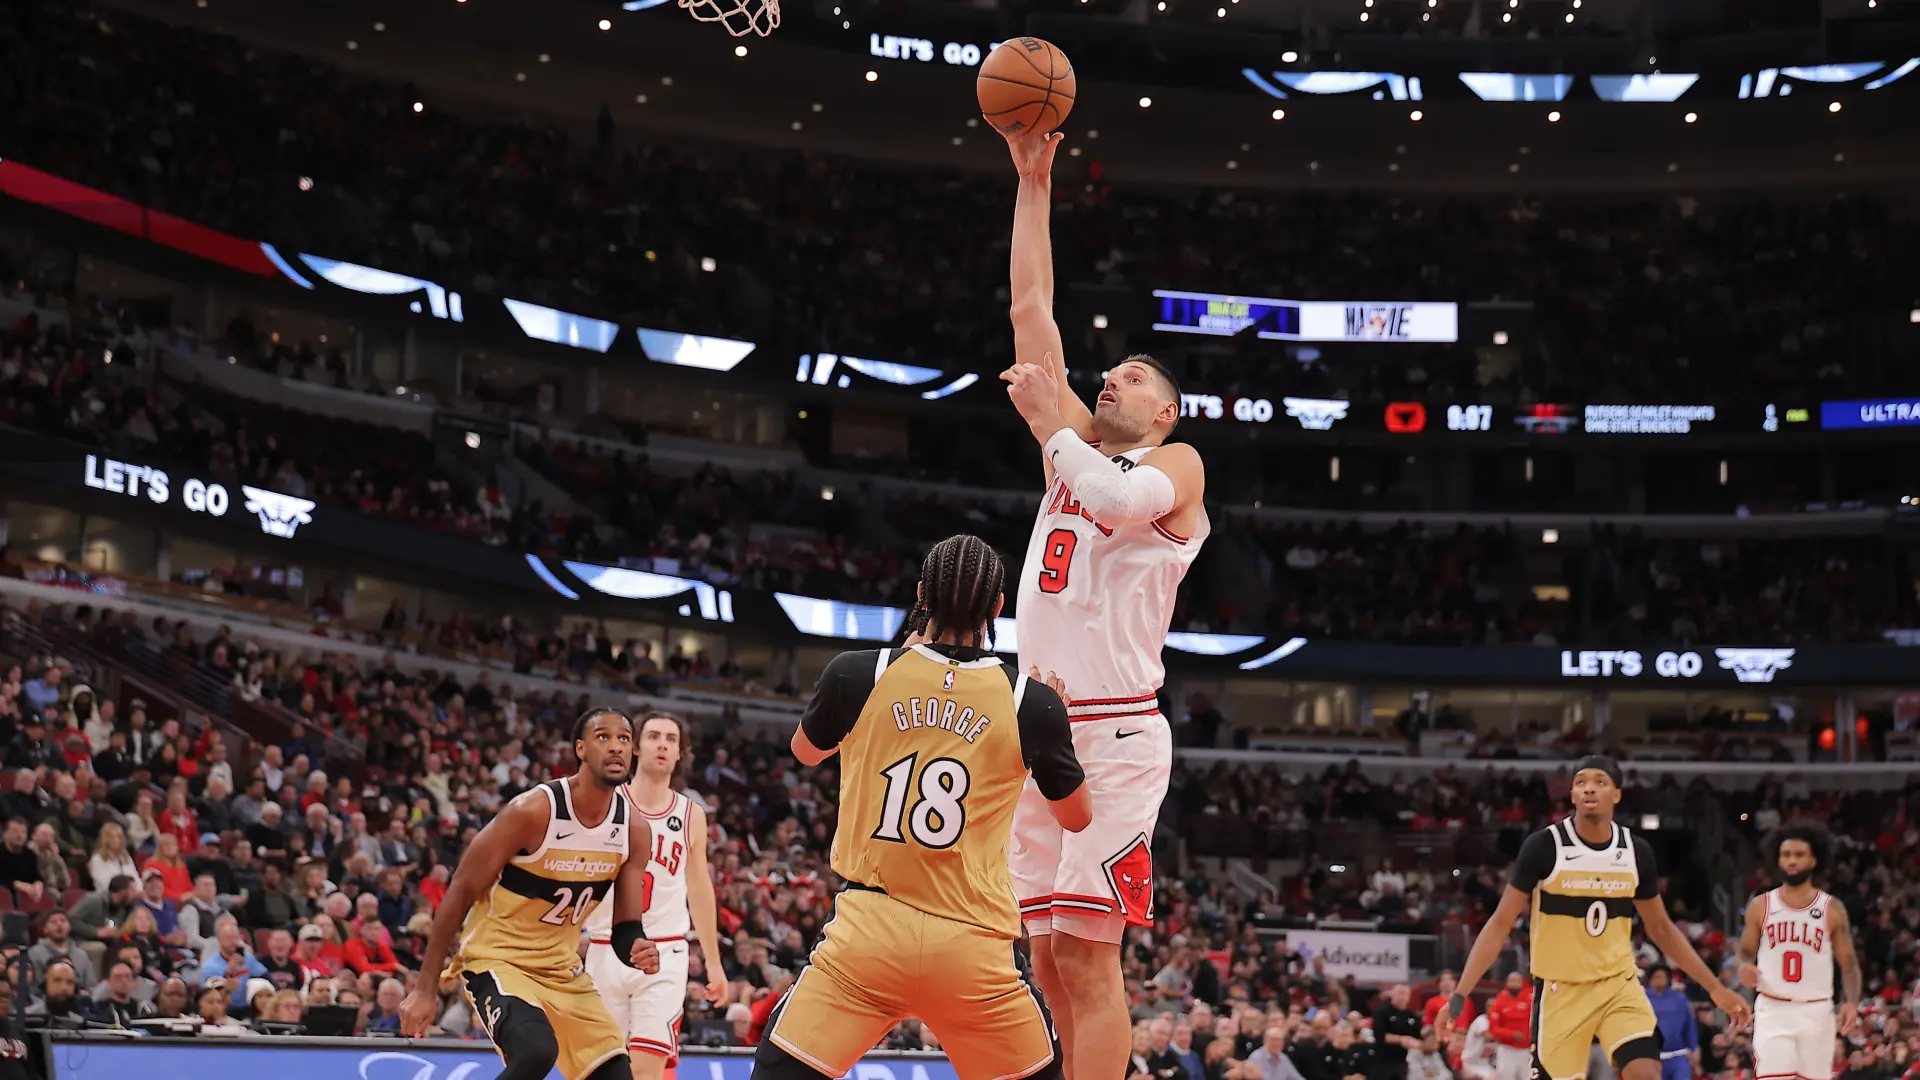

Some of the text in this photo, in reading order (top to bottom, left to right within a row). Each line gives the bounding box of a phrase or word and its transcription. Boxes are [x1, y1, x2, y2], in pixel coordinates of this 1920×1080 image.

[870, 33, 981, 66] LET'S GO
[1233, 397, 1274, 422] GO
[1860, 403, 1920, 422] ULTRA
[84, 454, 229, 517] LET'S GO
[1038, 528, 1078, 594] 9
[1561, 650, 1703, 677] LET'S GO
[891, 697, 991, 744] GEORGE
[870, 751, 971, 850] 18
[543, 855, 617, 877] washington
[1561, 875, 1632, 894] washington
[540, 886, 594, 926] 20
[1585, 900, 1608, 937] 0
[1767, 921, 1824, 953] BULLS
[1783, 950, 1803, 983] 0
